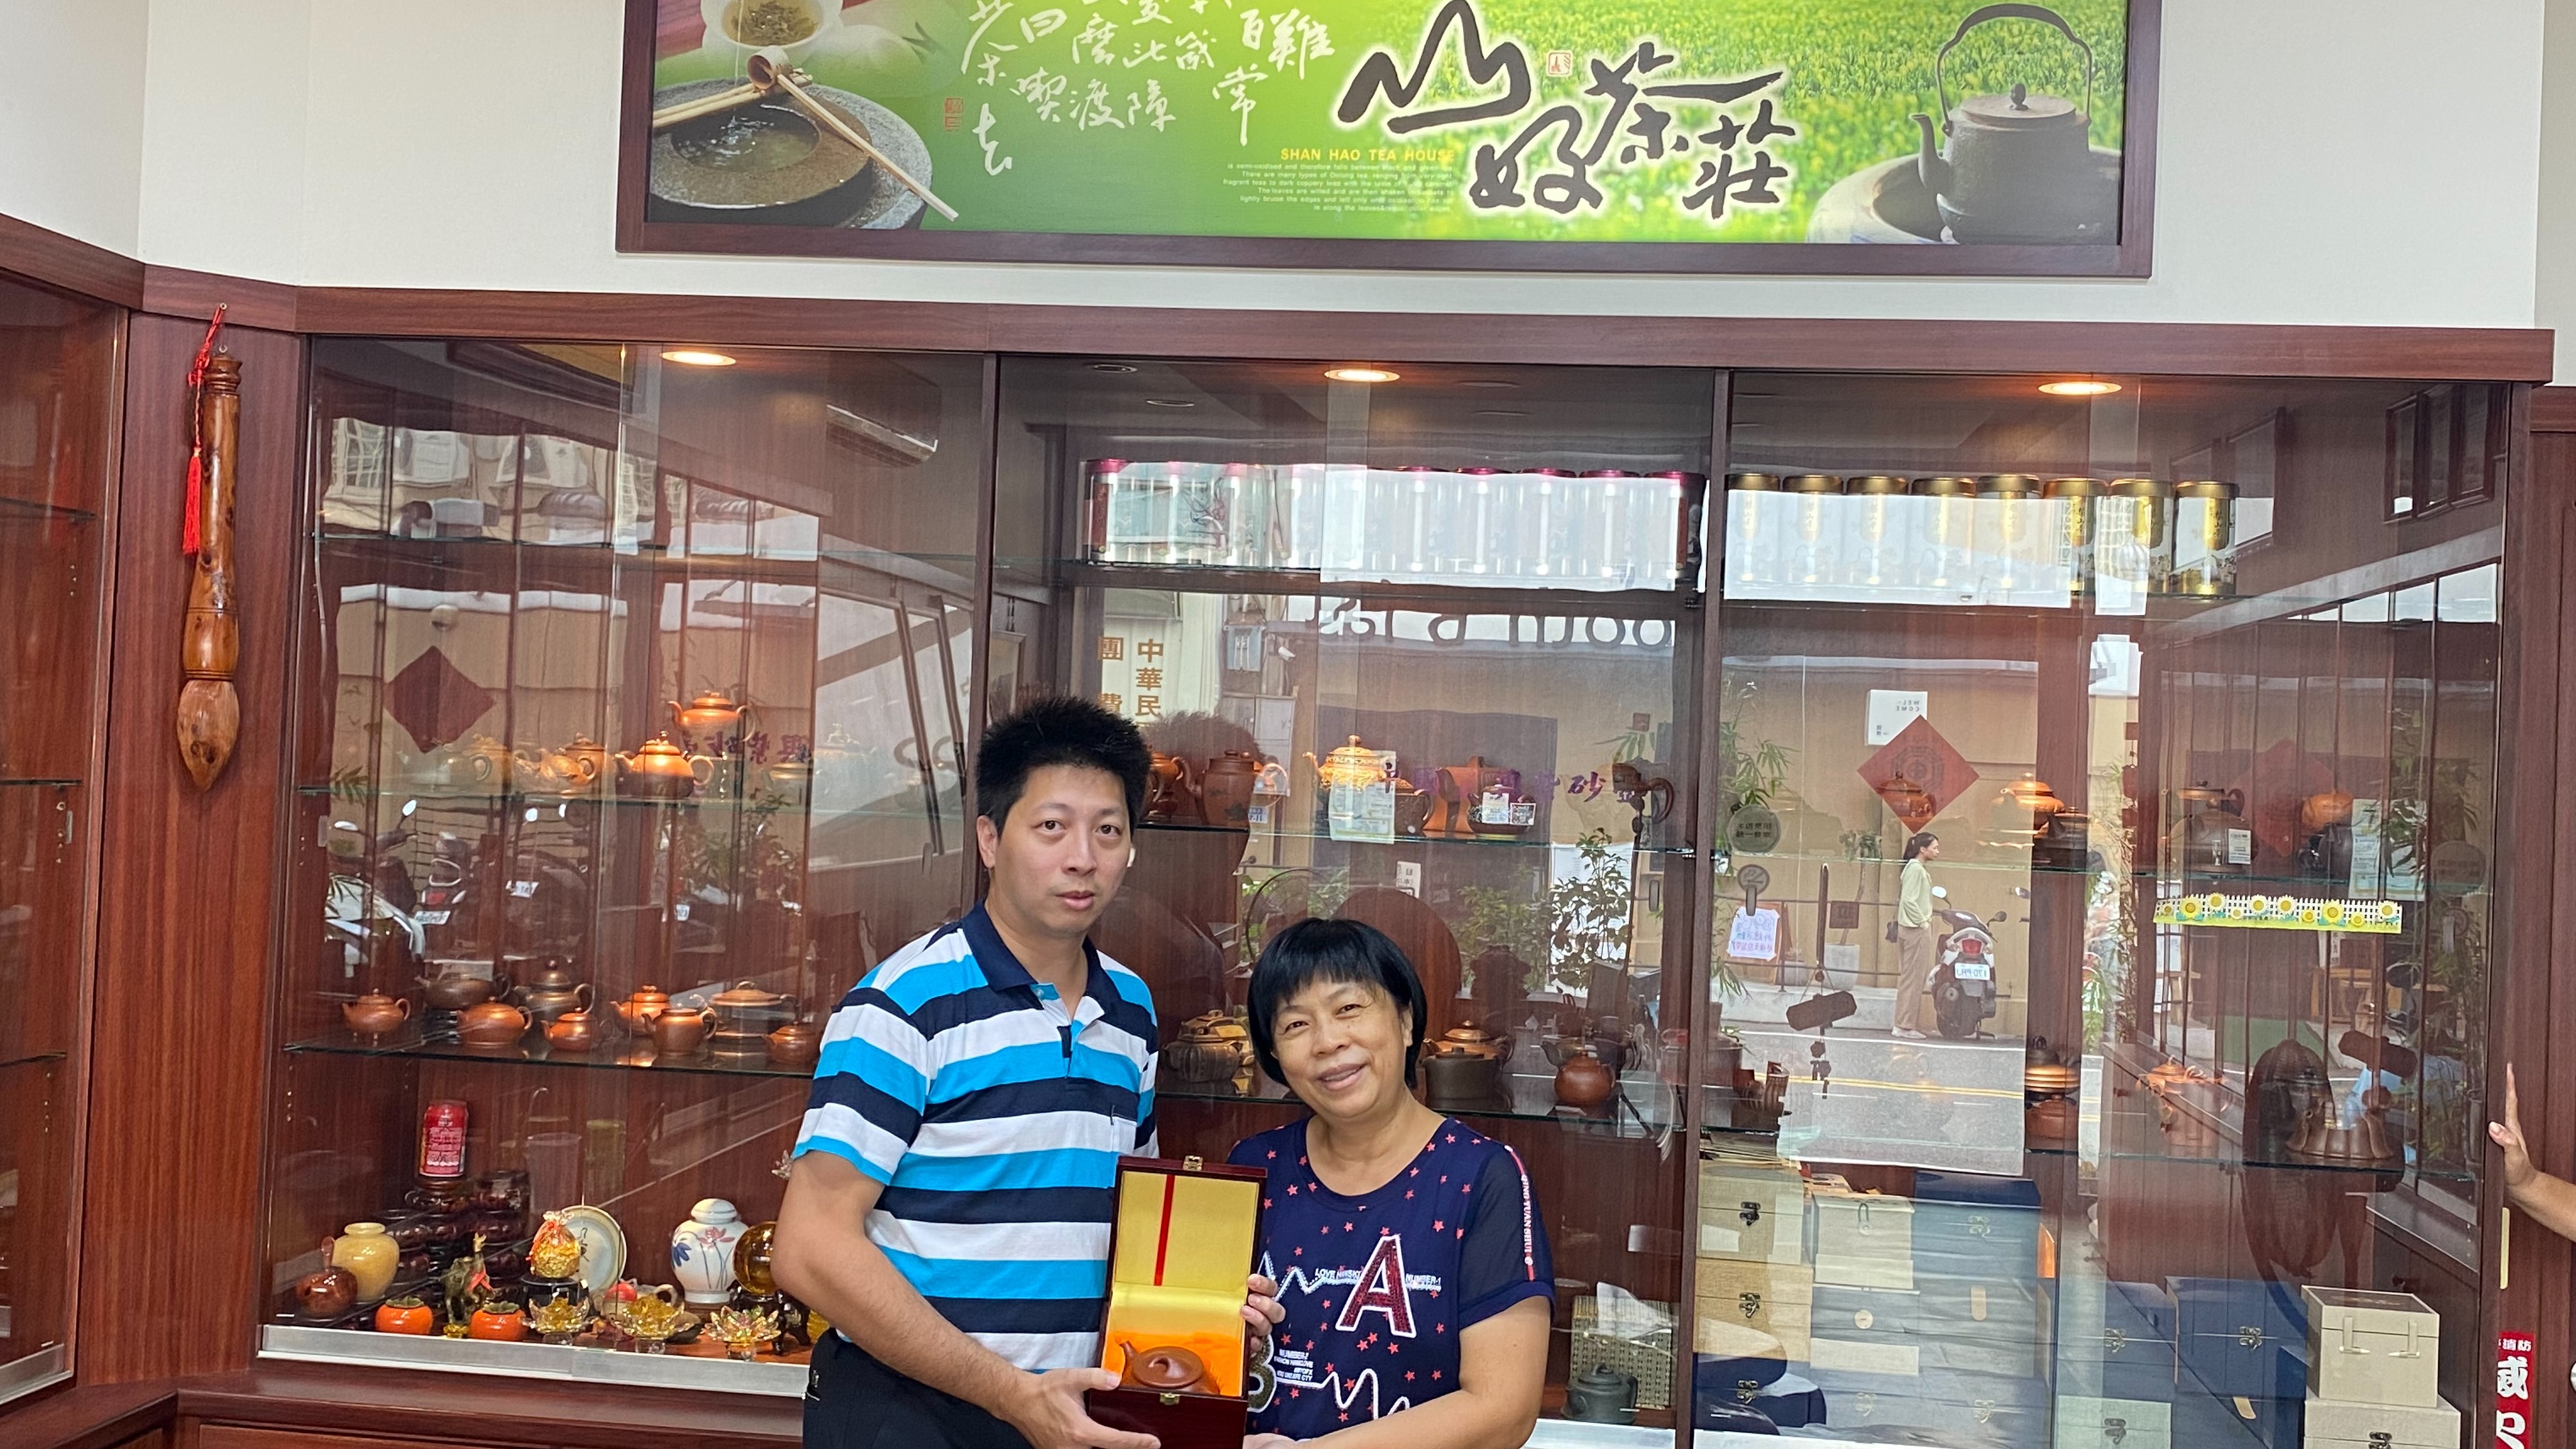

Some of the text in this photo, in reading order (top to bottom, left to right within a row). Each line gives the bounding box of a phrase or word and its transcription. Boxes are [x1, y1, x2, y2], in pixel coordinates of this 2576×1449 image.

[1280, 148, 1455, 162] SHAN HAO TEA HOUSE
[1135, 638, 1164, 726] 中華民
[1336, 1234, 1417, 1338] A
